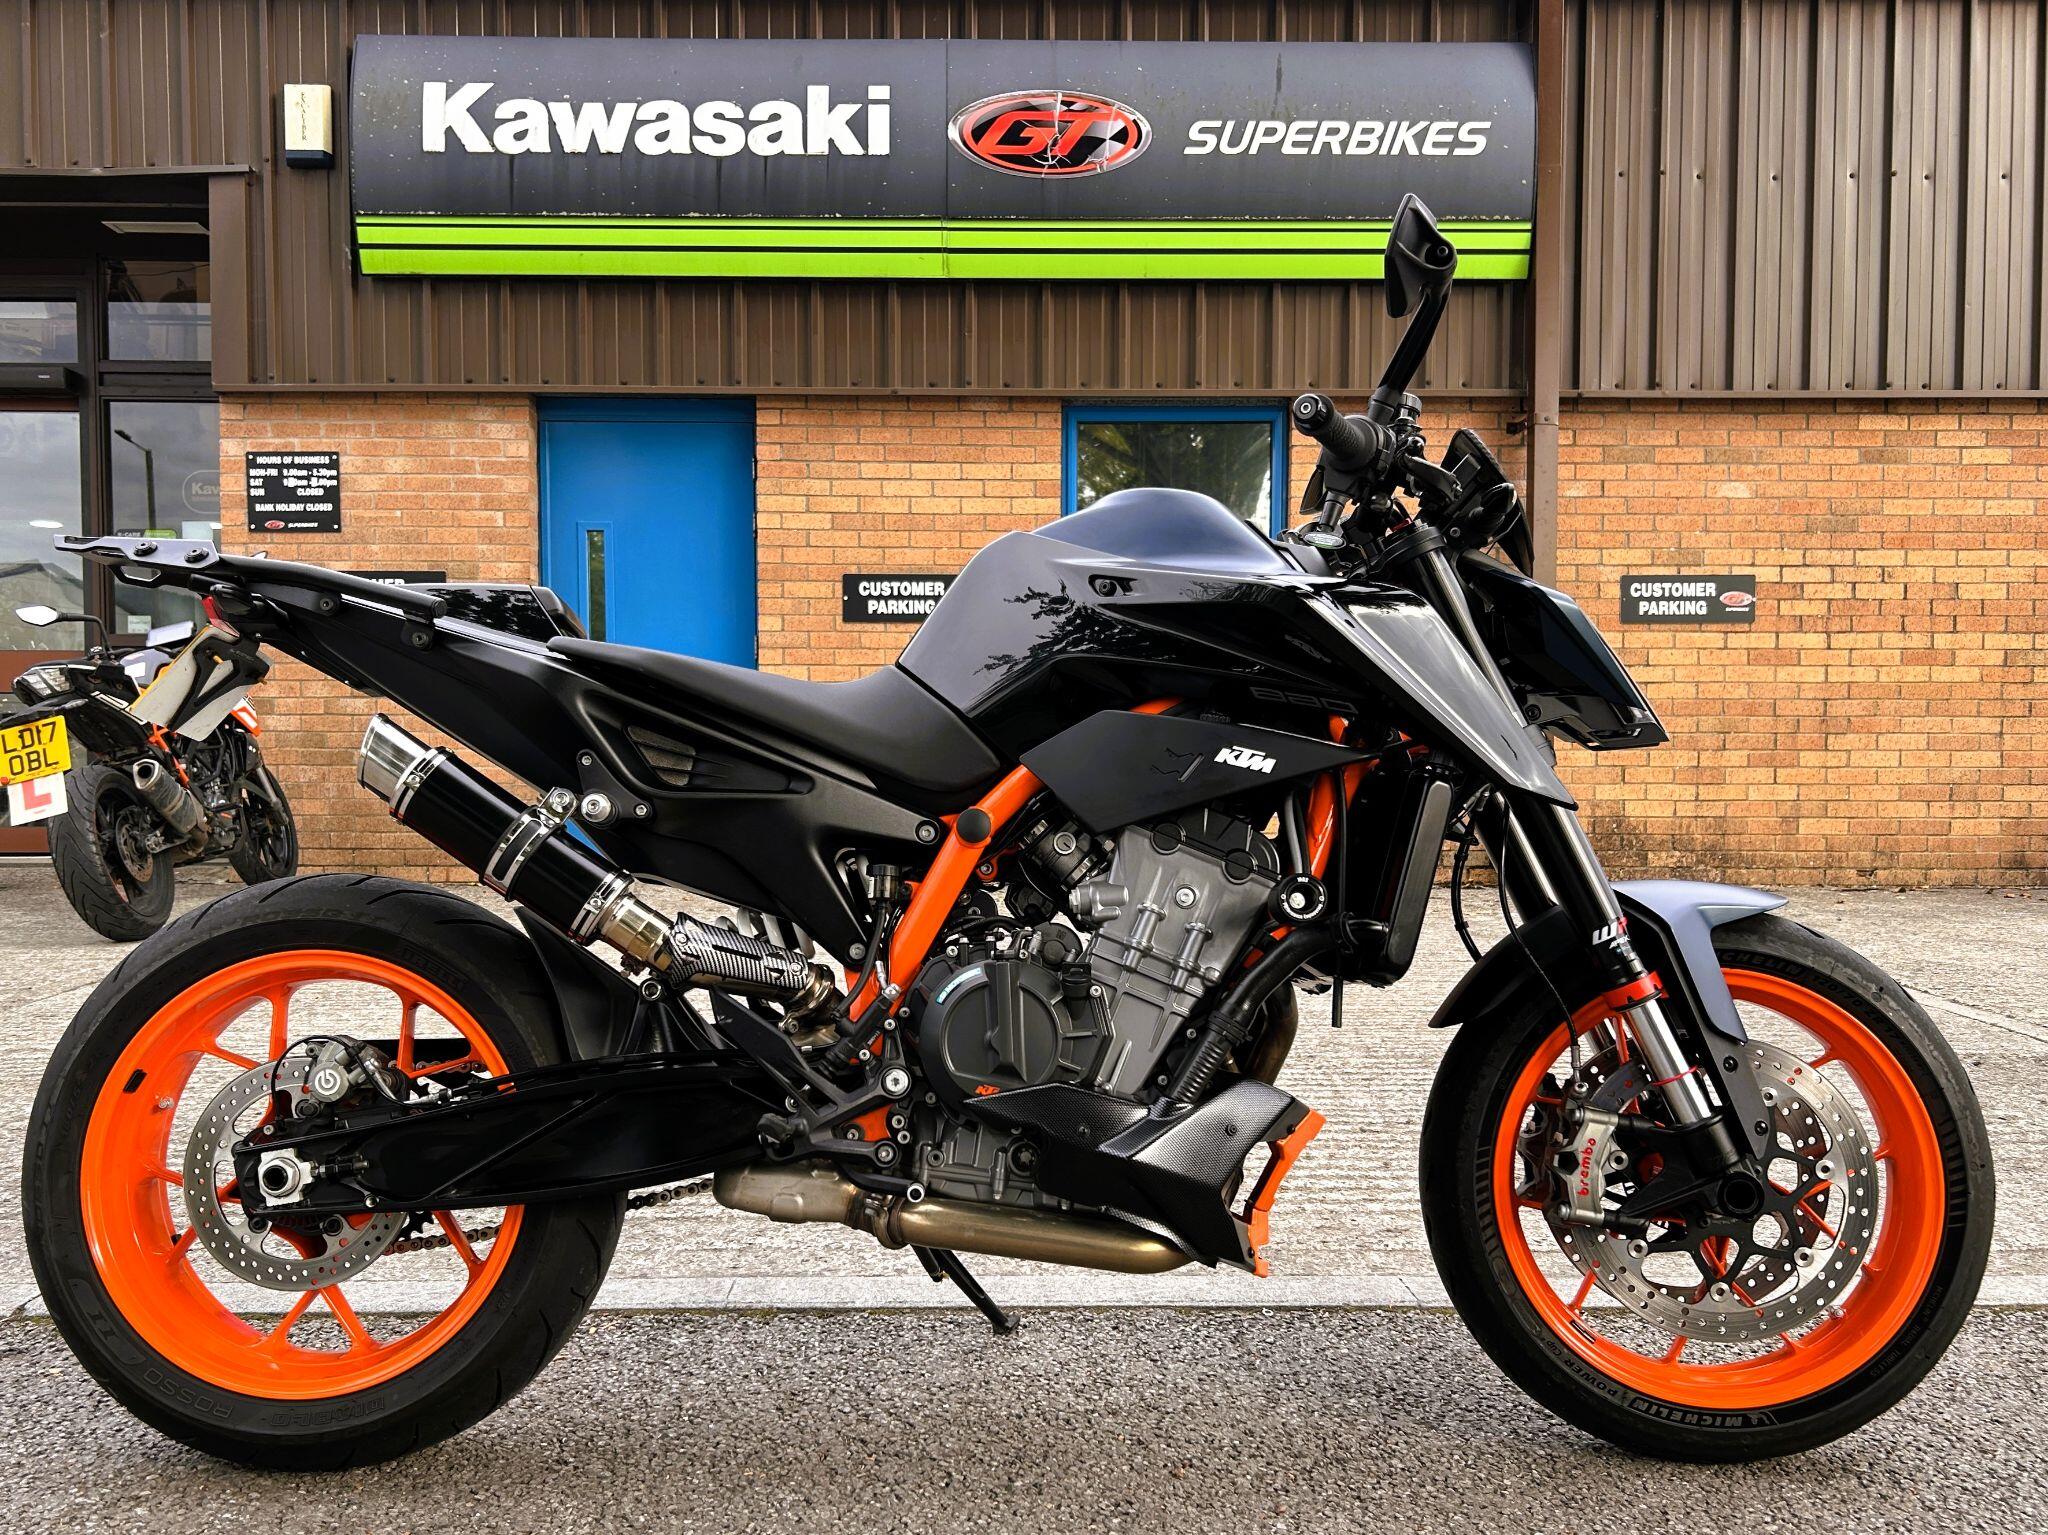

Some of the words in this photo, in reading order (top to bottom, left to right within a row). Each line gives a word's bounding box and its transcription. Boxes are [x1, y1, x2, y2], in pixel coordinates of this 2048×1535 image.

[422, 81, 891, 156] Kawasaki
[975, 111, 1123, 156] GT
[1183, 120, 1492, 156] SUPERBIKES
[256, 456, 281, 464] HOURS
[283, 456, 293, 464] OF
[294, 456, 330, 464] BUSINESS
[249, 478, 263, 487] SAT
[249, 488, 265, 497] SUN
[296, 488, 325, 496] CLOSED
[255, 503, 275, 512] BANK
[275, 503, 305, 512] HOLIDAY
[305, 503, 333, 512] CLOSED
[858, 581, 946, 597] CUSTOMER
[1630, 582, 1716, 598] CUSTOMER
[867, 600, 936, 615] PARKING
[1639, 600, 1708, 616] PARKING
[1, 721, 56, 755] LD17
[8, 747, 60, 777] OBL
[1213, 745, 1277, 775] KTM
[1577, 1137, 1597, 1197] brembo
[1563, 1357, 1619, 1397] POWER
[143, 1367, 234, 1418] ROSSO
[1633, 1399, 1744, 1428] MICHELIN
